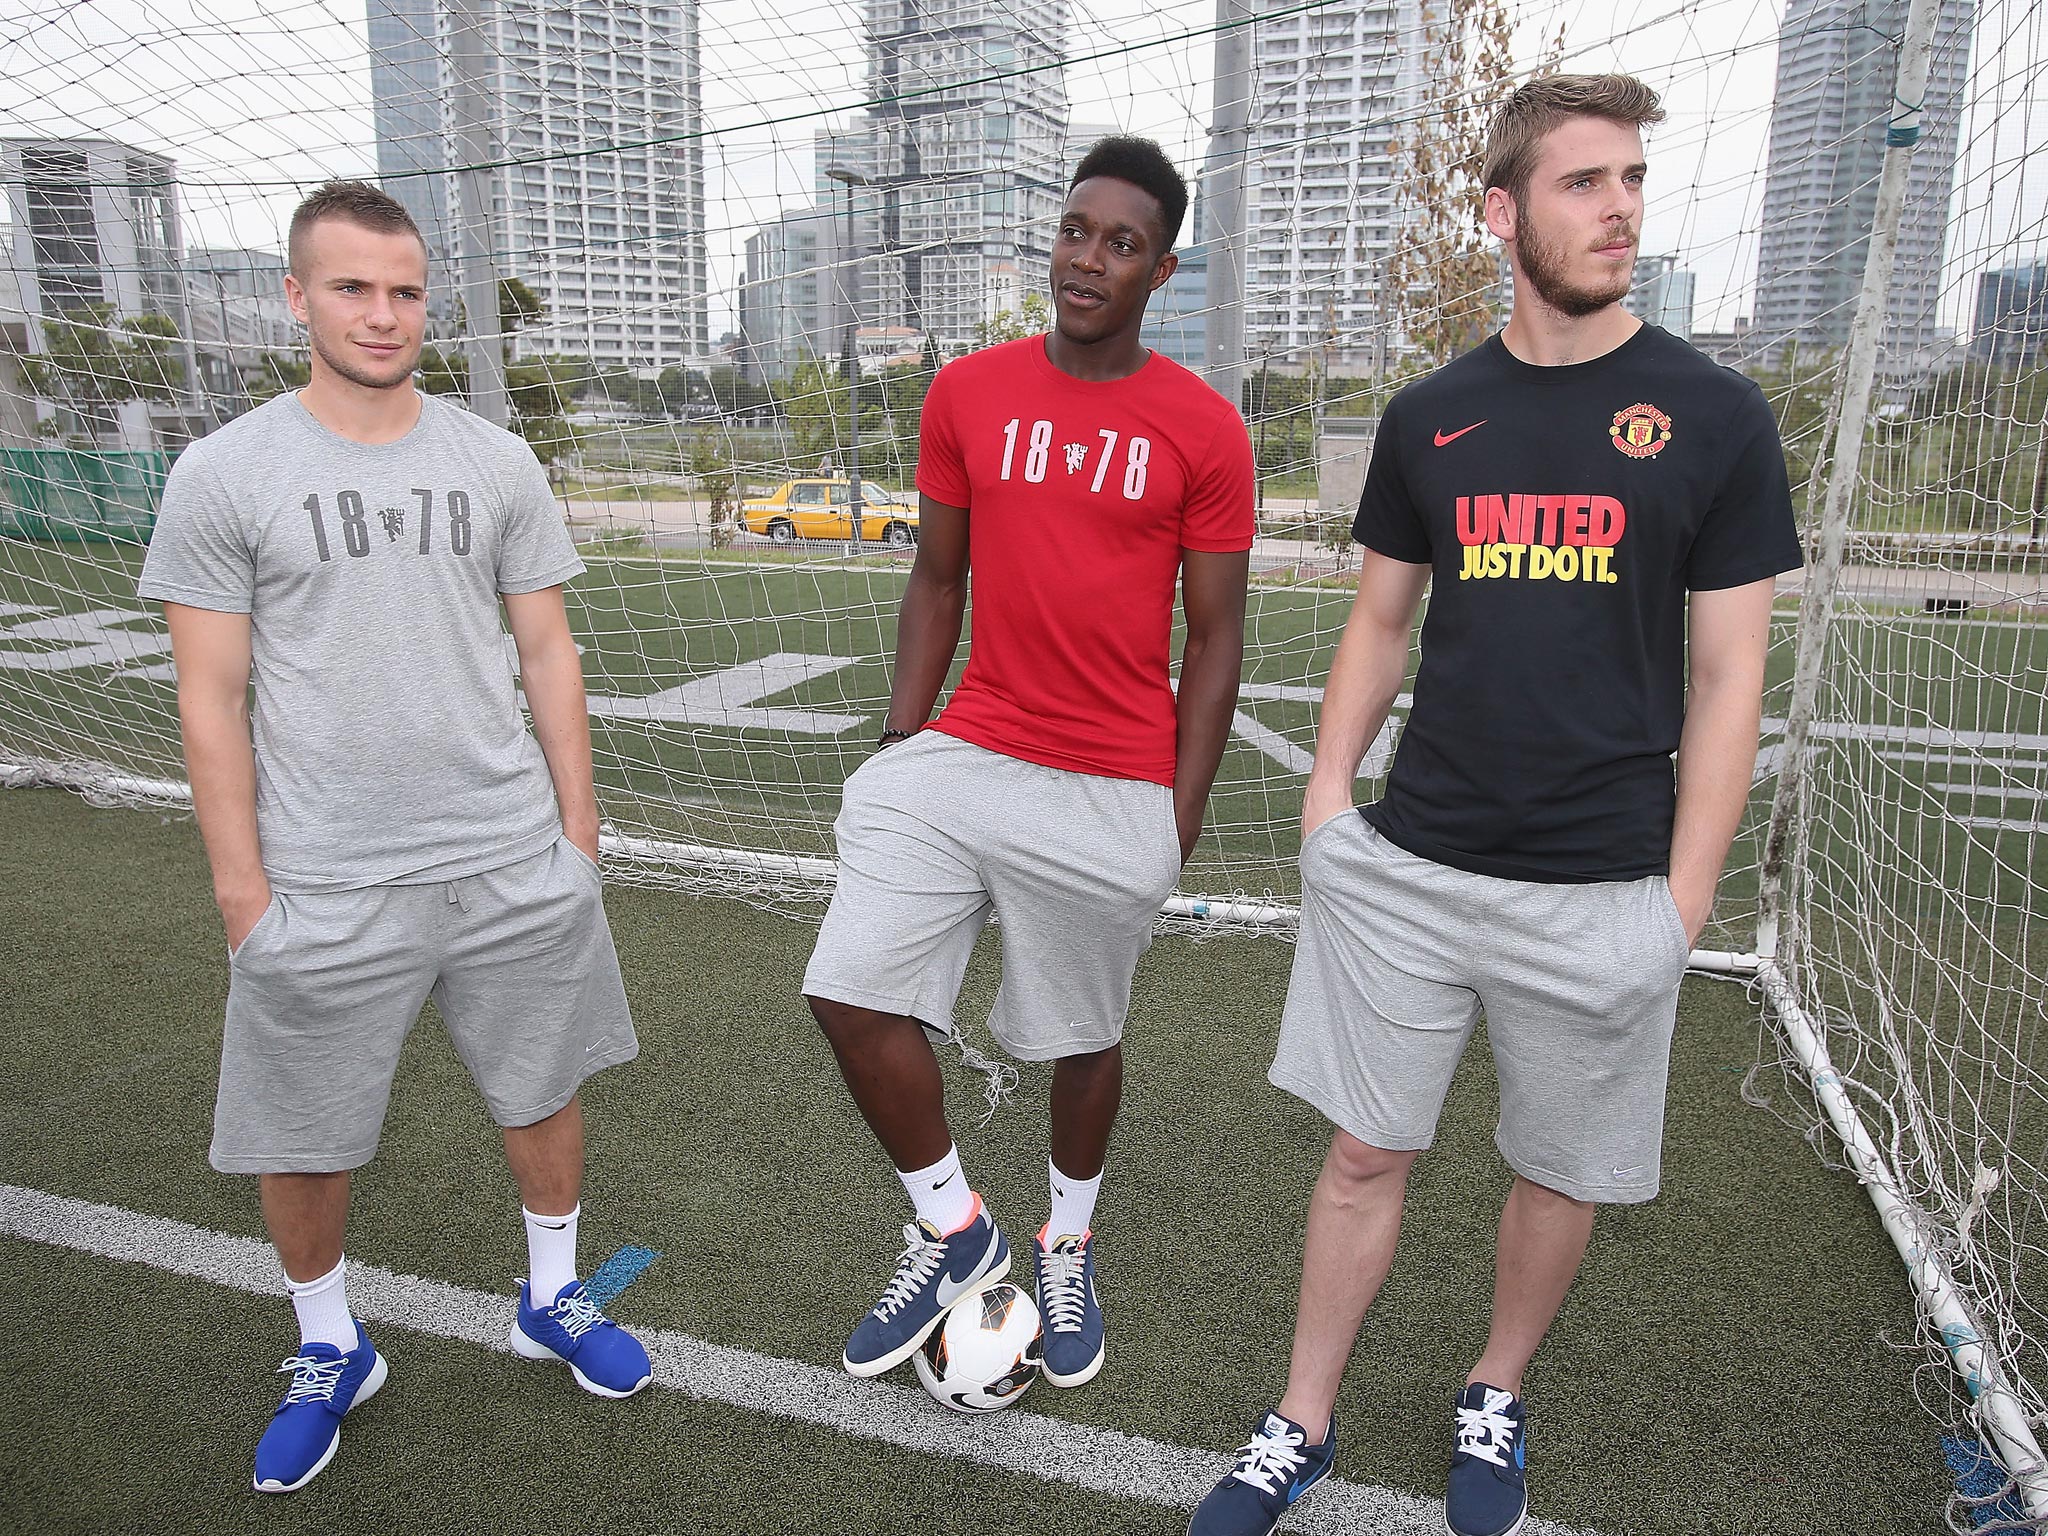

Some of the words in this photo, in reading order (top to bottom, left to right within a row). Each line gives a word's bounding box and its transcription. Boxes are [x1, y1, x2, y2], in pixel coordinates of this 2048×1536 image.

[1617, 406, 1667, 427] MANCHESTER
[1000, 418, 1054, 484] 18
[1090, 428, 1151, 501] 78
[1621, 443, 1656, 455] UNITED
[302, 489, 370, 563] 18
[410, 487, 472, 556] 78
[1455, 493, 1627, 547] UNITED
[1458, 543, 1527, 581] JUST
[1528, 544, 1580, 582] DO
[1582, 546, 1618, 584] IT.
